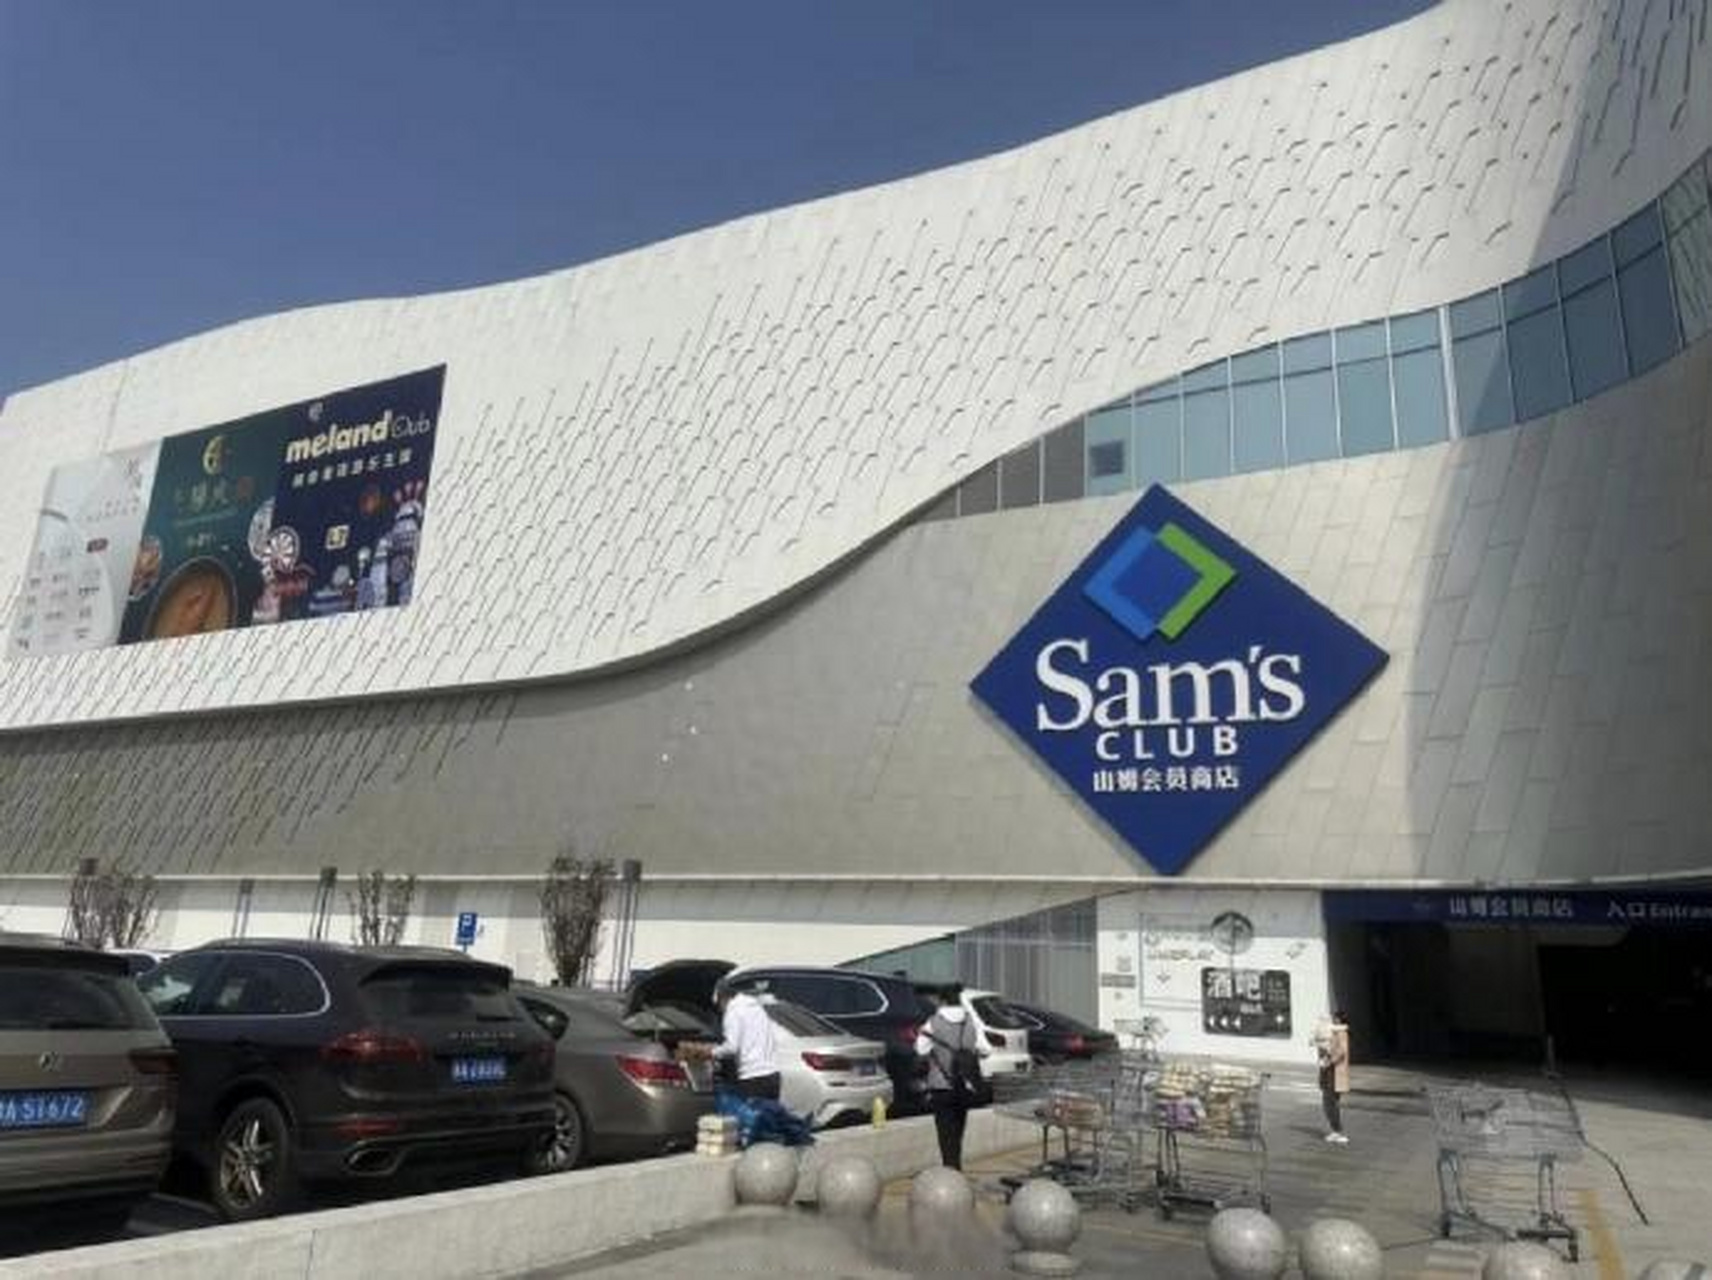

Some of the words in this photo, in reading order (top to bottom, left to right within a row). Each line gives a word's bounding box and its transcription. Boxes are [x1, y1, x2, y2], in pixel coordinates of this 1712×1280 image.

[285, 410, 392, 463] meland
[1036, 638, 1304, 731] Sam's
[1095, 725, 1239, 761] CLUB
[1092, 764, 1240, 792] 山姆会员商店
